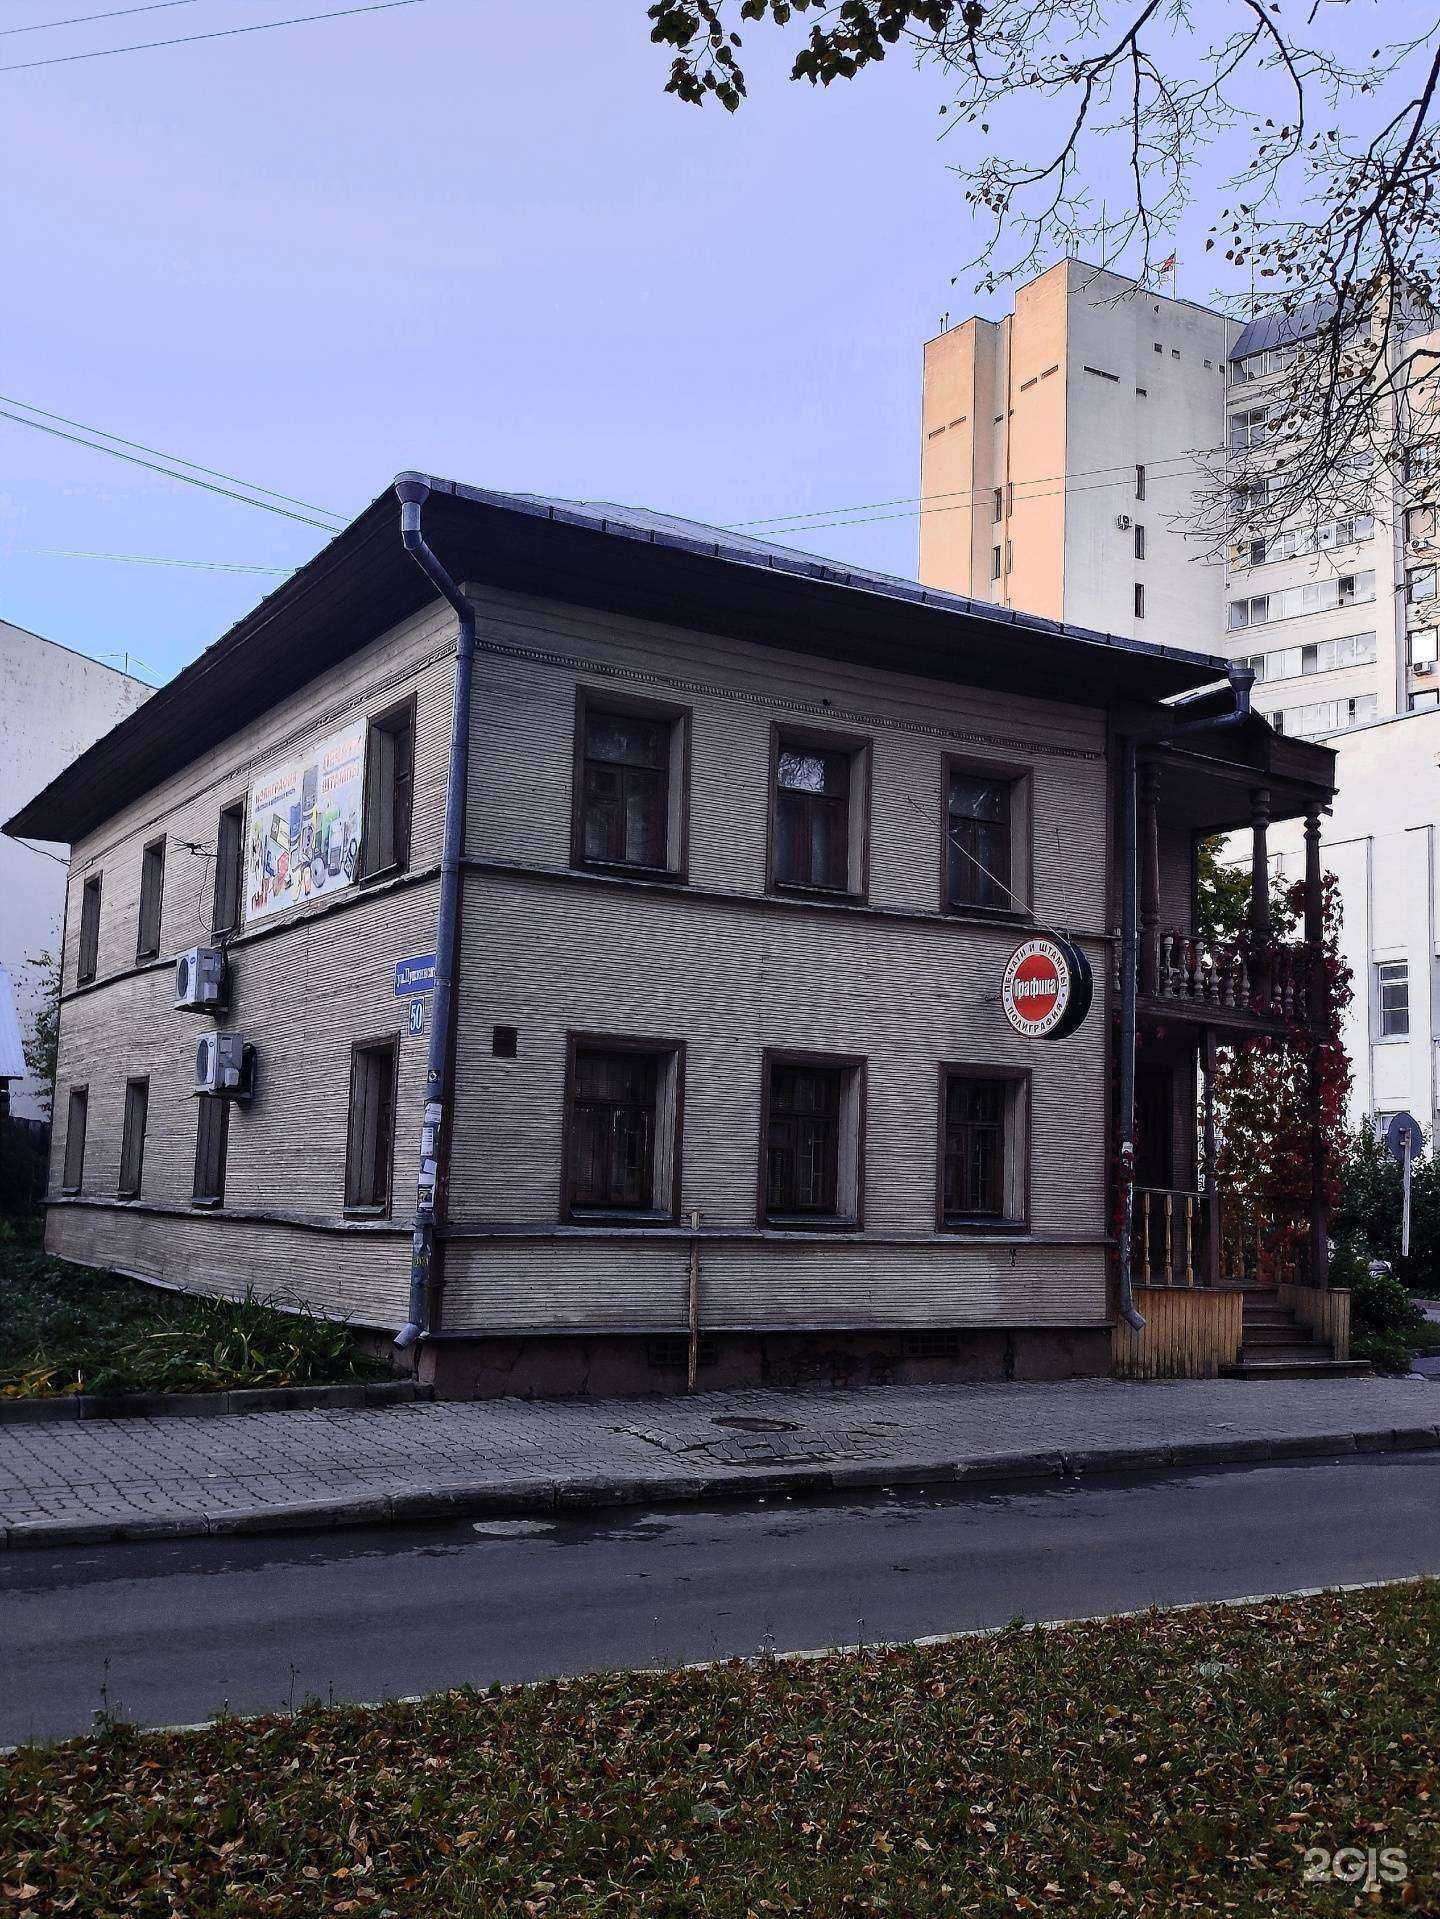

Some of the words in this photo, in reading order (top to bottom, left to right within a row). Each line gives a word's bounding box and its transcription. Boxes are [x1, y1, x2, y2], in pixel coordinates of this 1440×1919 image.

[1003, 949, 1026, 993] ПЕЧАТИ
[1028, 943, 1036, 952] И
[1039, 942, 1068, 987] ШТАМПЫ
[1013, 977, 1058, 999] Графика
[410, 1002, 423, 1031] 50
[1006, 1003, 1064, 1034] ПОЛИГРАФИЯ
